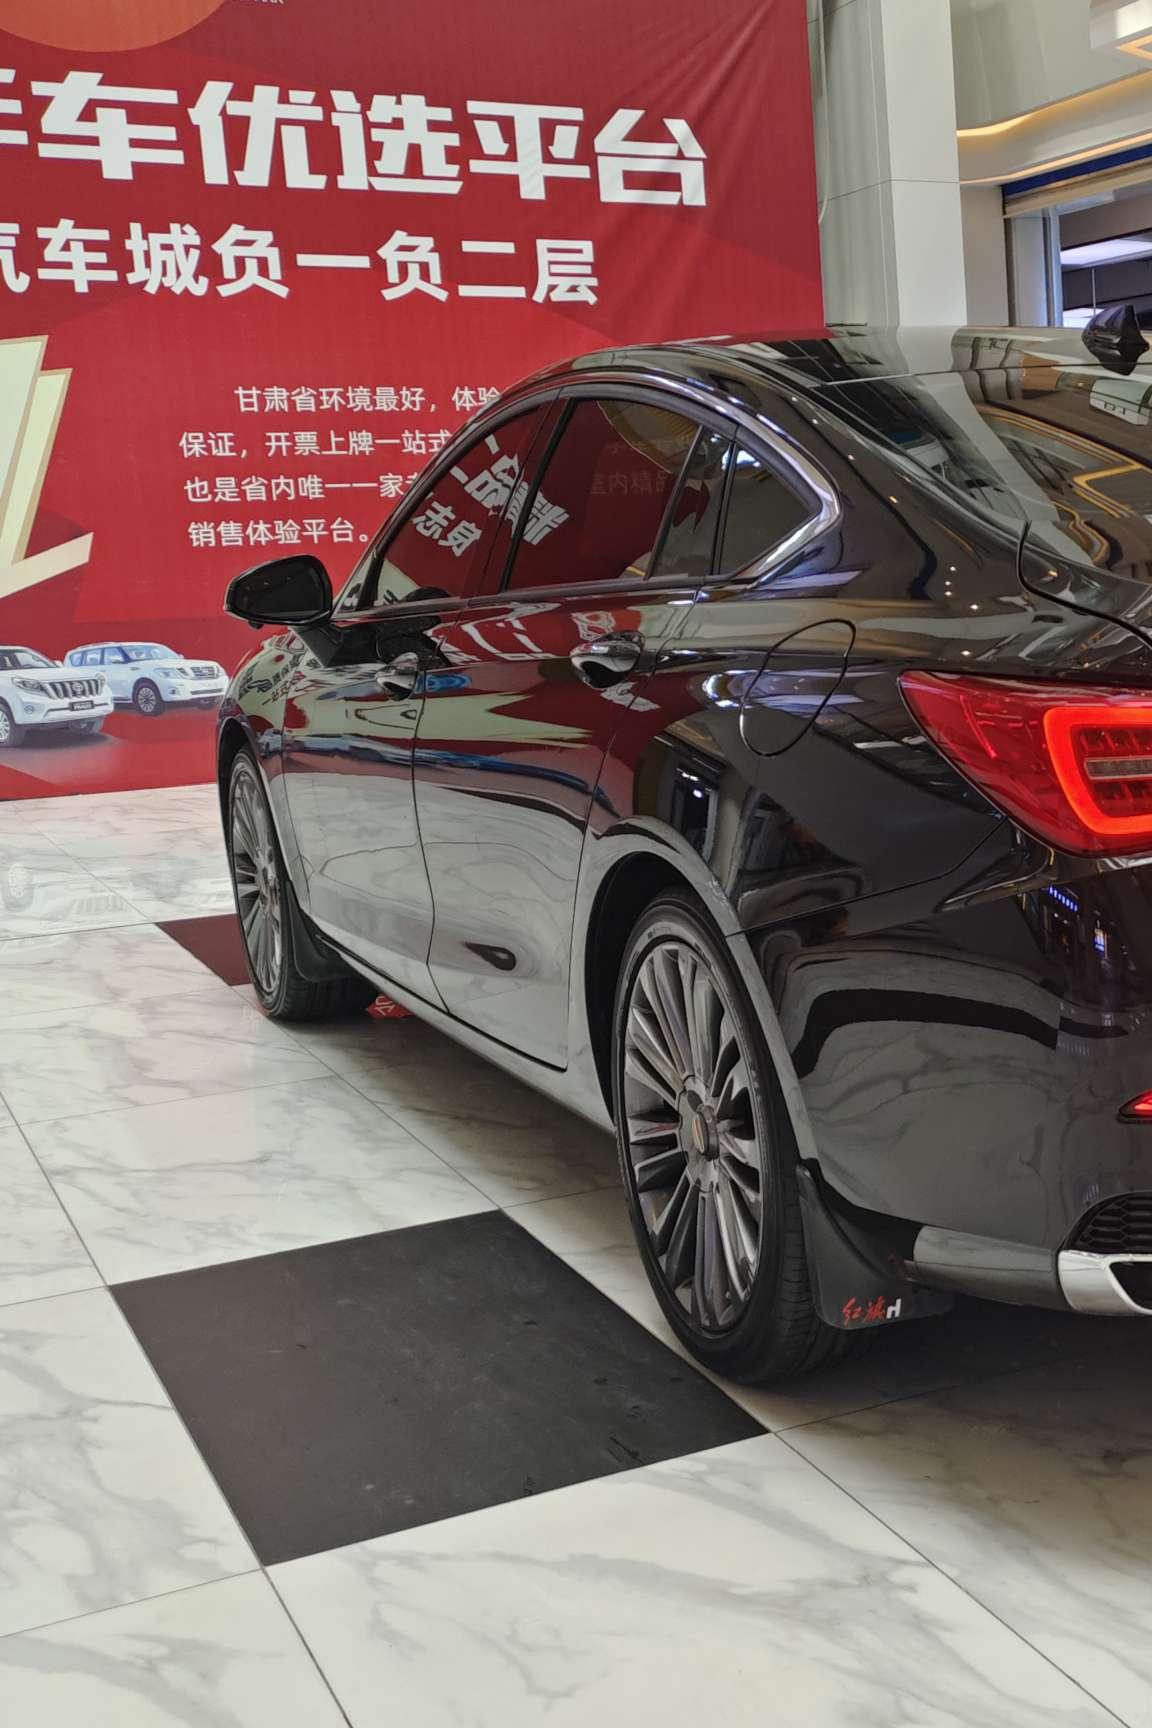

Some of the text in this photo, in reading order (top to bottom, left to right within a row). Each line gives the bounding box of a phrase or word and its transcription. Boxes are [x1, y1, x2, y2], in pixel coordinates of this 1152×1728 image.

[0, 68, 707, 206] 车优选平台
[183, 472, 418, 503] 也是省内唯一一家
